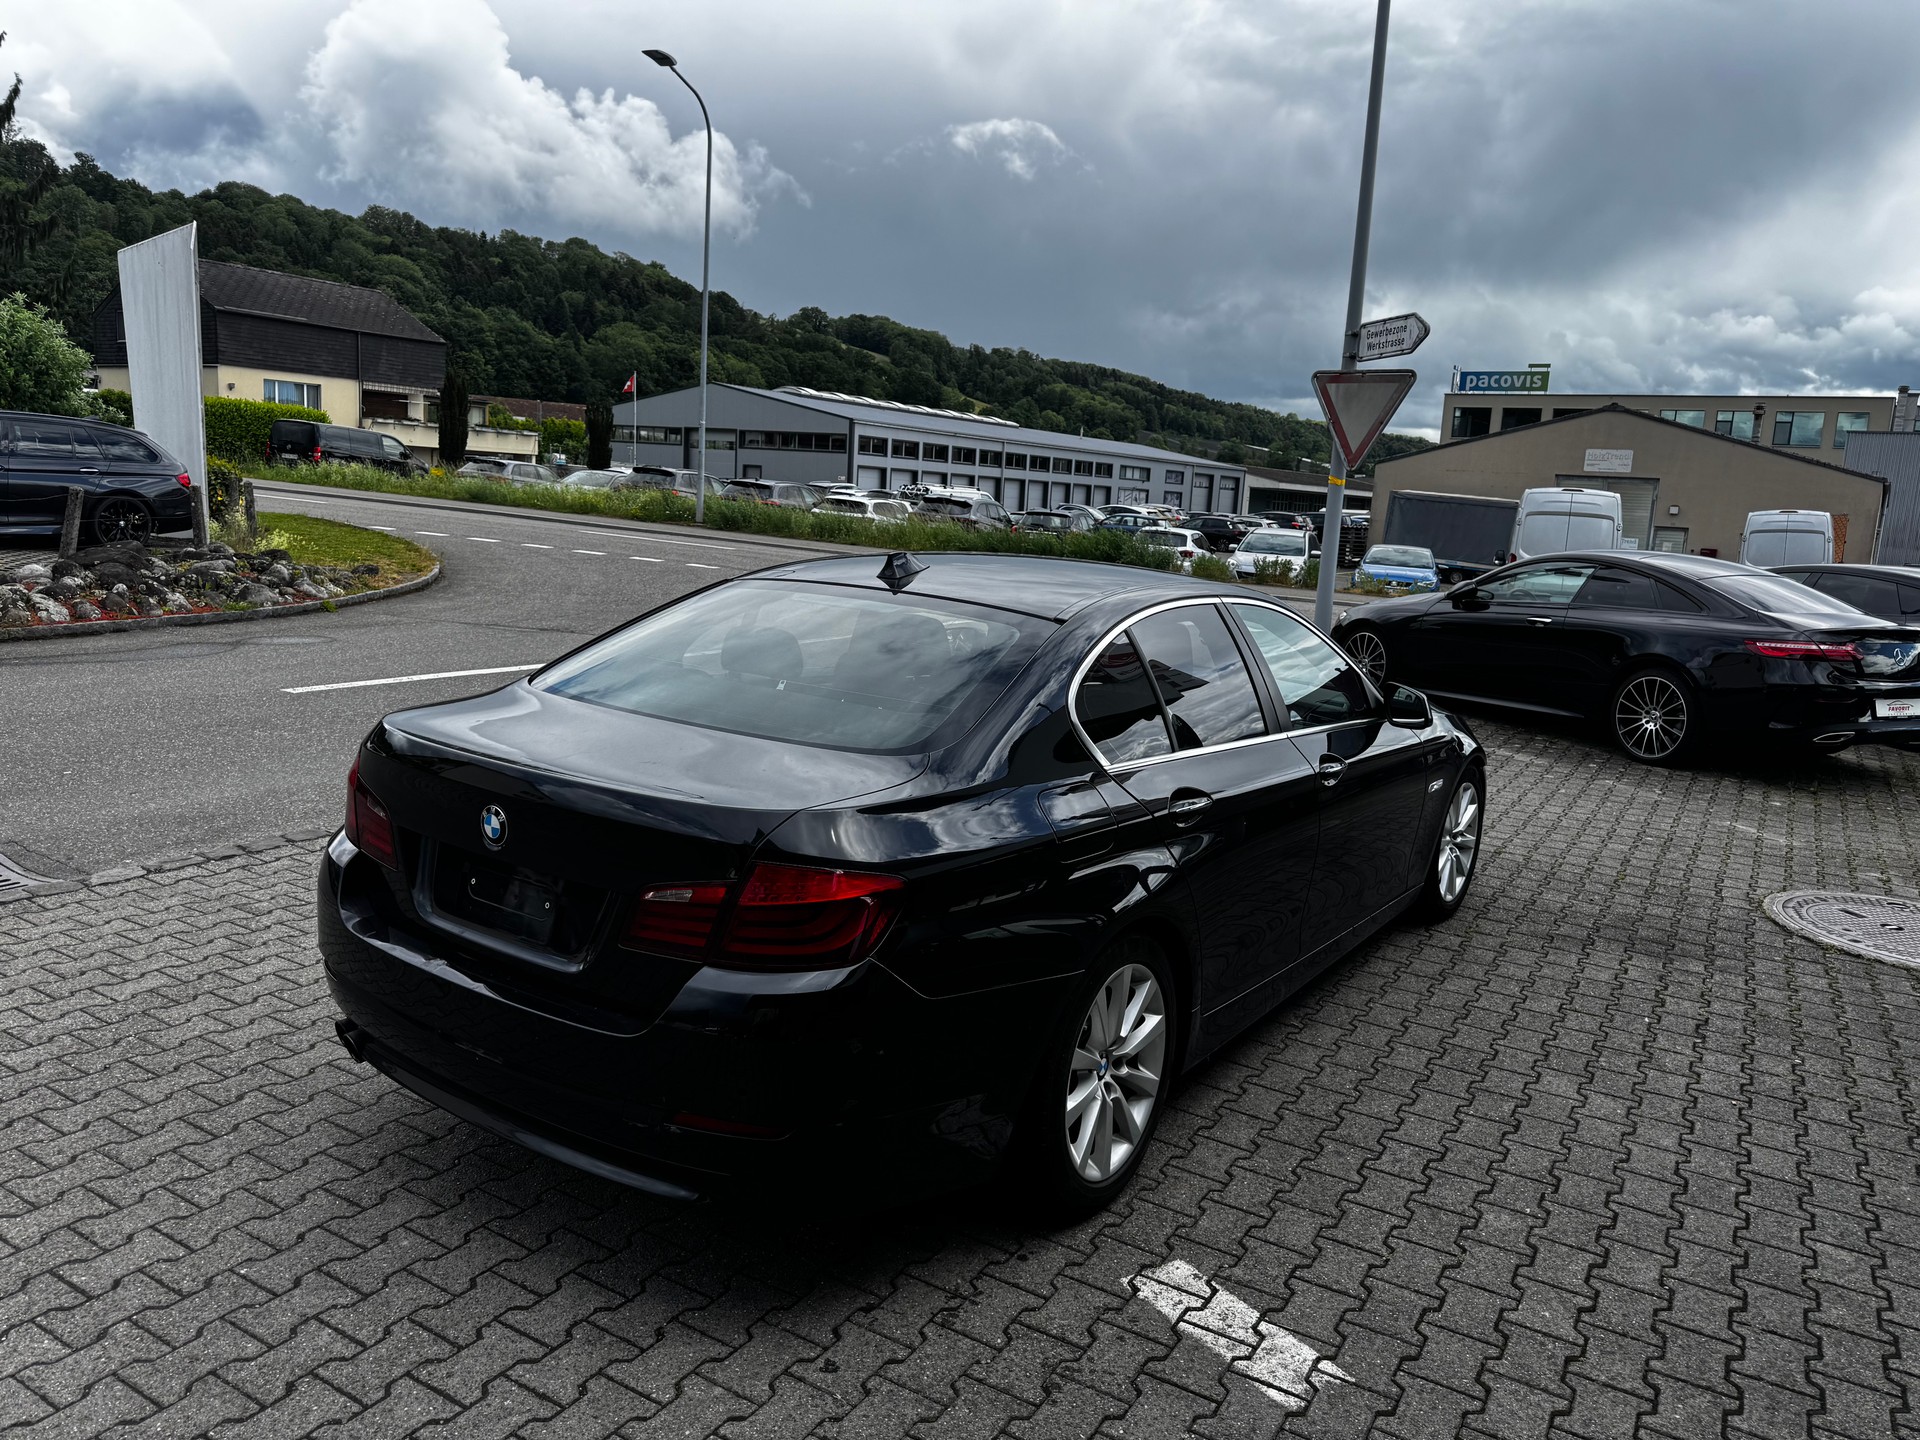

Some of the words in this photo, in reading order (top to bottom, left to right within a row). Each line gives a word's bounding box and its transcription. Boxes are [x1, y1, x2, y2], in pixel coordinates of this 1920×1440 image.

[1366, 325, 1408, 340] Gewerbezone
[1366, 338, 1405, 351] Werkstrasse
[1465, 375, 1542, 391] pacovis
[482, 806, 505, 822] BMW
